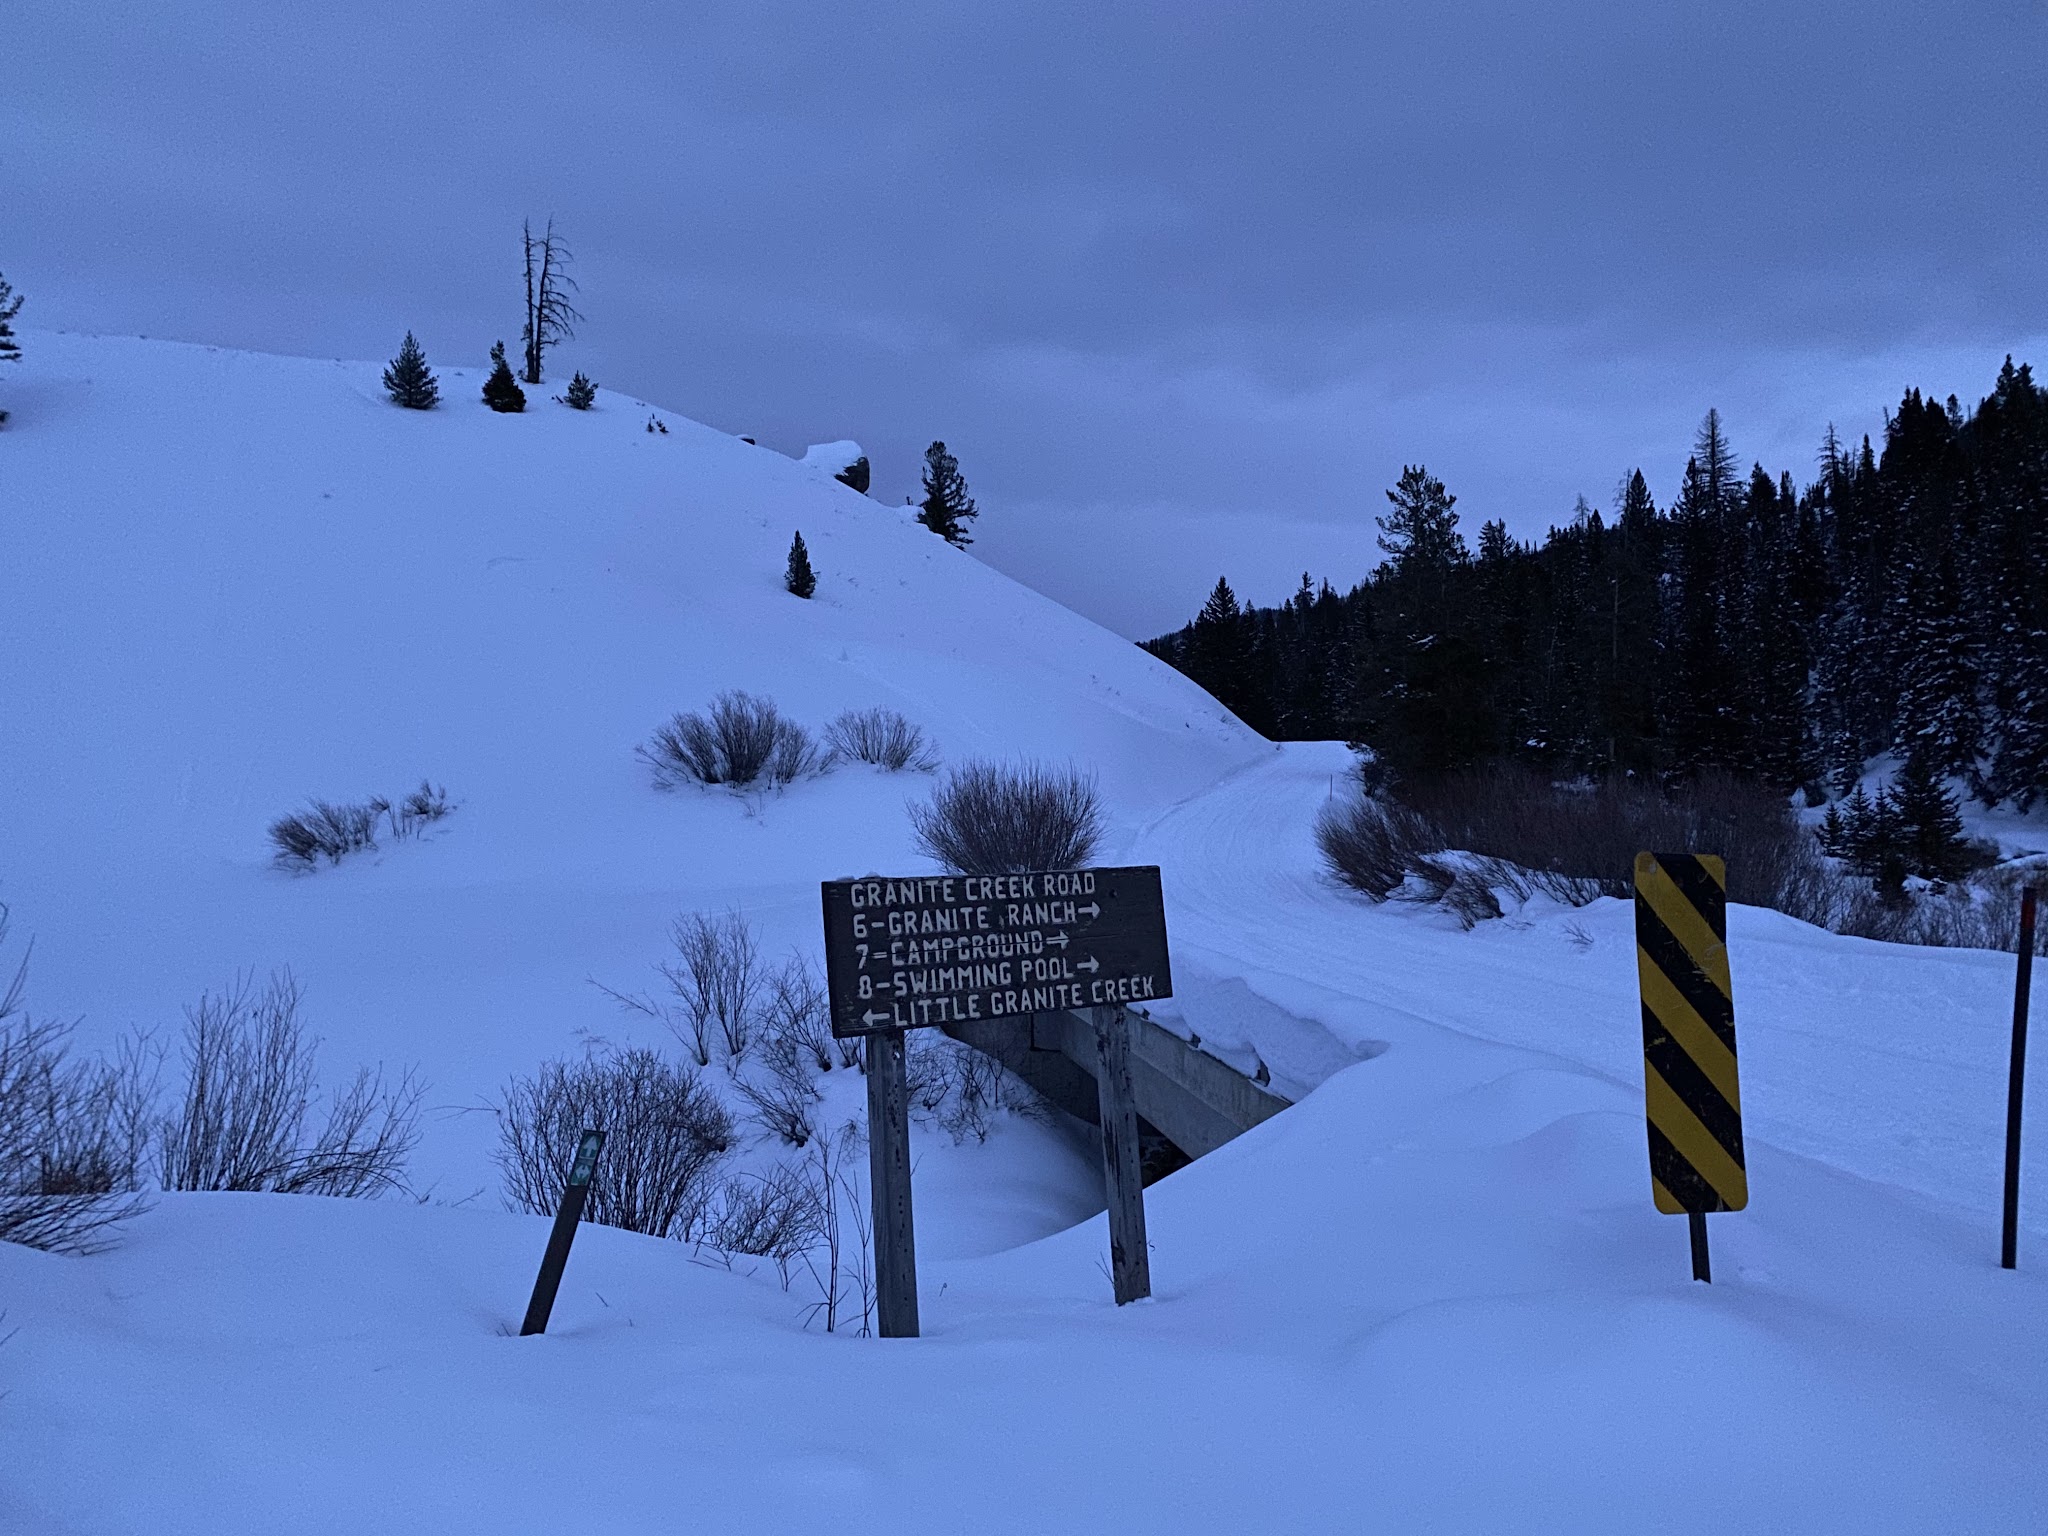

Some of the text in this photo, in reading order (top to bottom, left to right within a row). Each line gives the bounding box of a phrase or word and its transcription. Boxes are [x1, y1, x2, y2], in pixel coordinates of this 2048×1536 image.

[851, 872, 1096, 907] GRANITE CREEK ROAD
[1008, 901, 1076, 926] RANCH
[1021, 957, 1074, 982] POOL
[894, 976, 1154, 1026] LITTLE GRANITE CREEK
